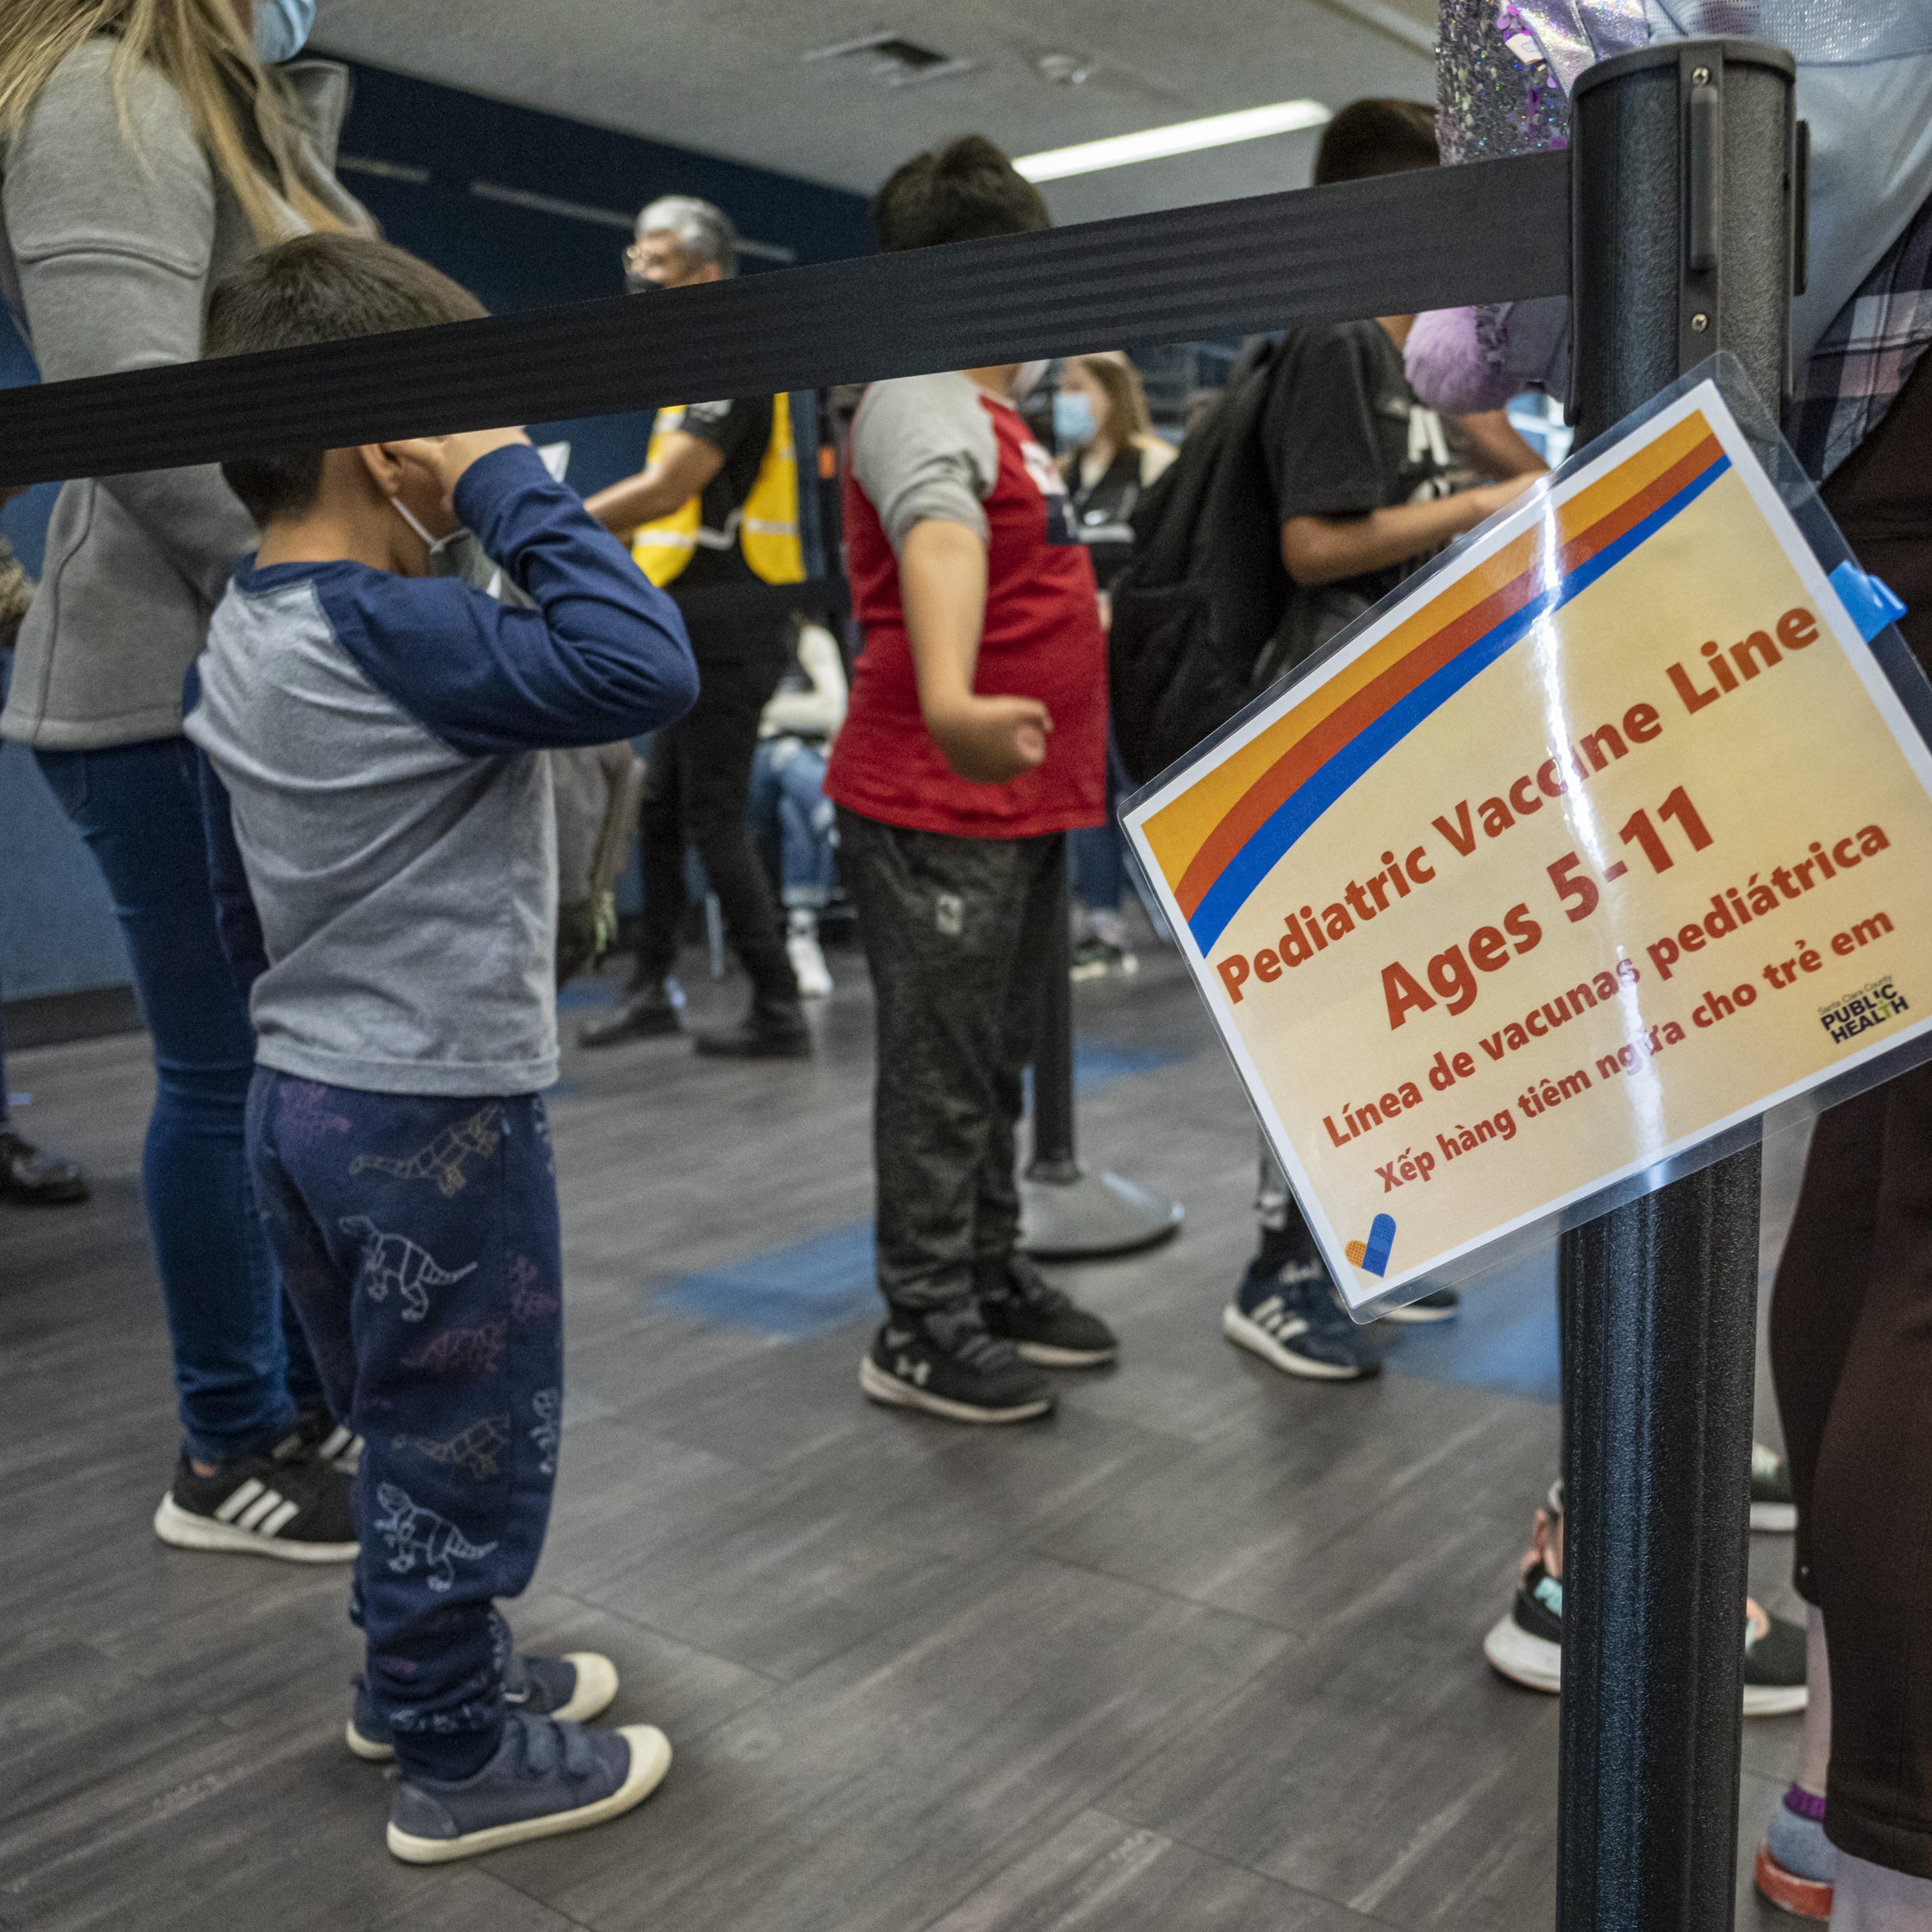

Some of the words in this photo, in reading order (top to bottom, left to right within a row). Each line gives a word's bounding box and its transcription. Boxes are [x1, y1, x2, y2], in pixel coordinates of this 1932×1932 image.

[1216, 845, 1436, 1005] Pediatric
[1665, 608, 1819, 715] Line
[1381, 903, 1543, 1031] Ages
[1546, 785, 1714, 923] 5-11
[1322, 1081, 1424, 1148] Línea
[1428, 1051, 1476, 1092] de
[1478, 957, 1641, 1062] vacunas
[1646, 824, 1891, 981] pediátrica
[1374, 1146, 1435, 1194] Xếp
[1435, 1108, 1517, 1161] hàng
[1517, 1070, 1592, 1118] tiêm
[1692, 983, 1757, 1028] cho
[1762, 939, 1823, 990] trẻ
[1830, 912, 1895, 956] em
[1820, 983, 1897, 1031] PUBLIC
[1830, 995, 1909, 1044] HEALTH
